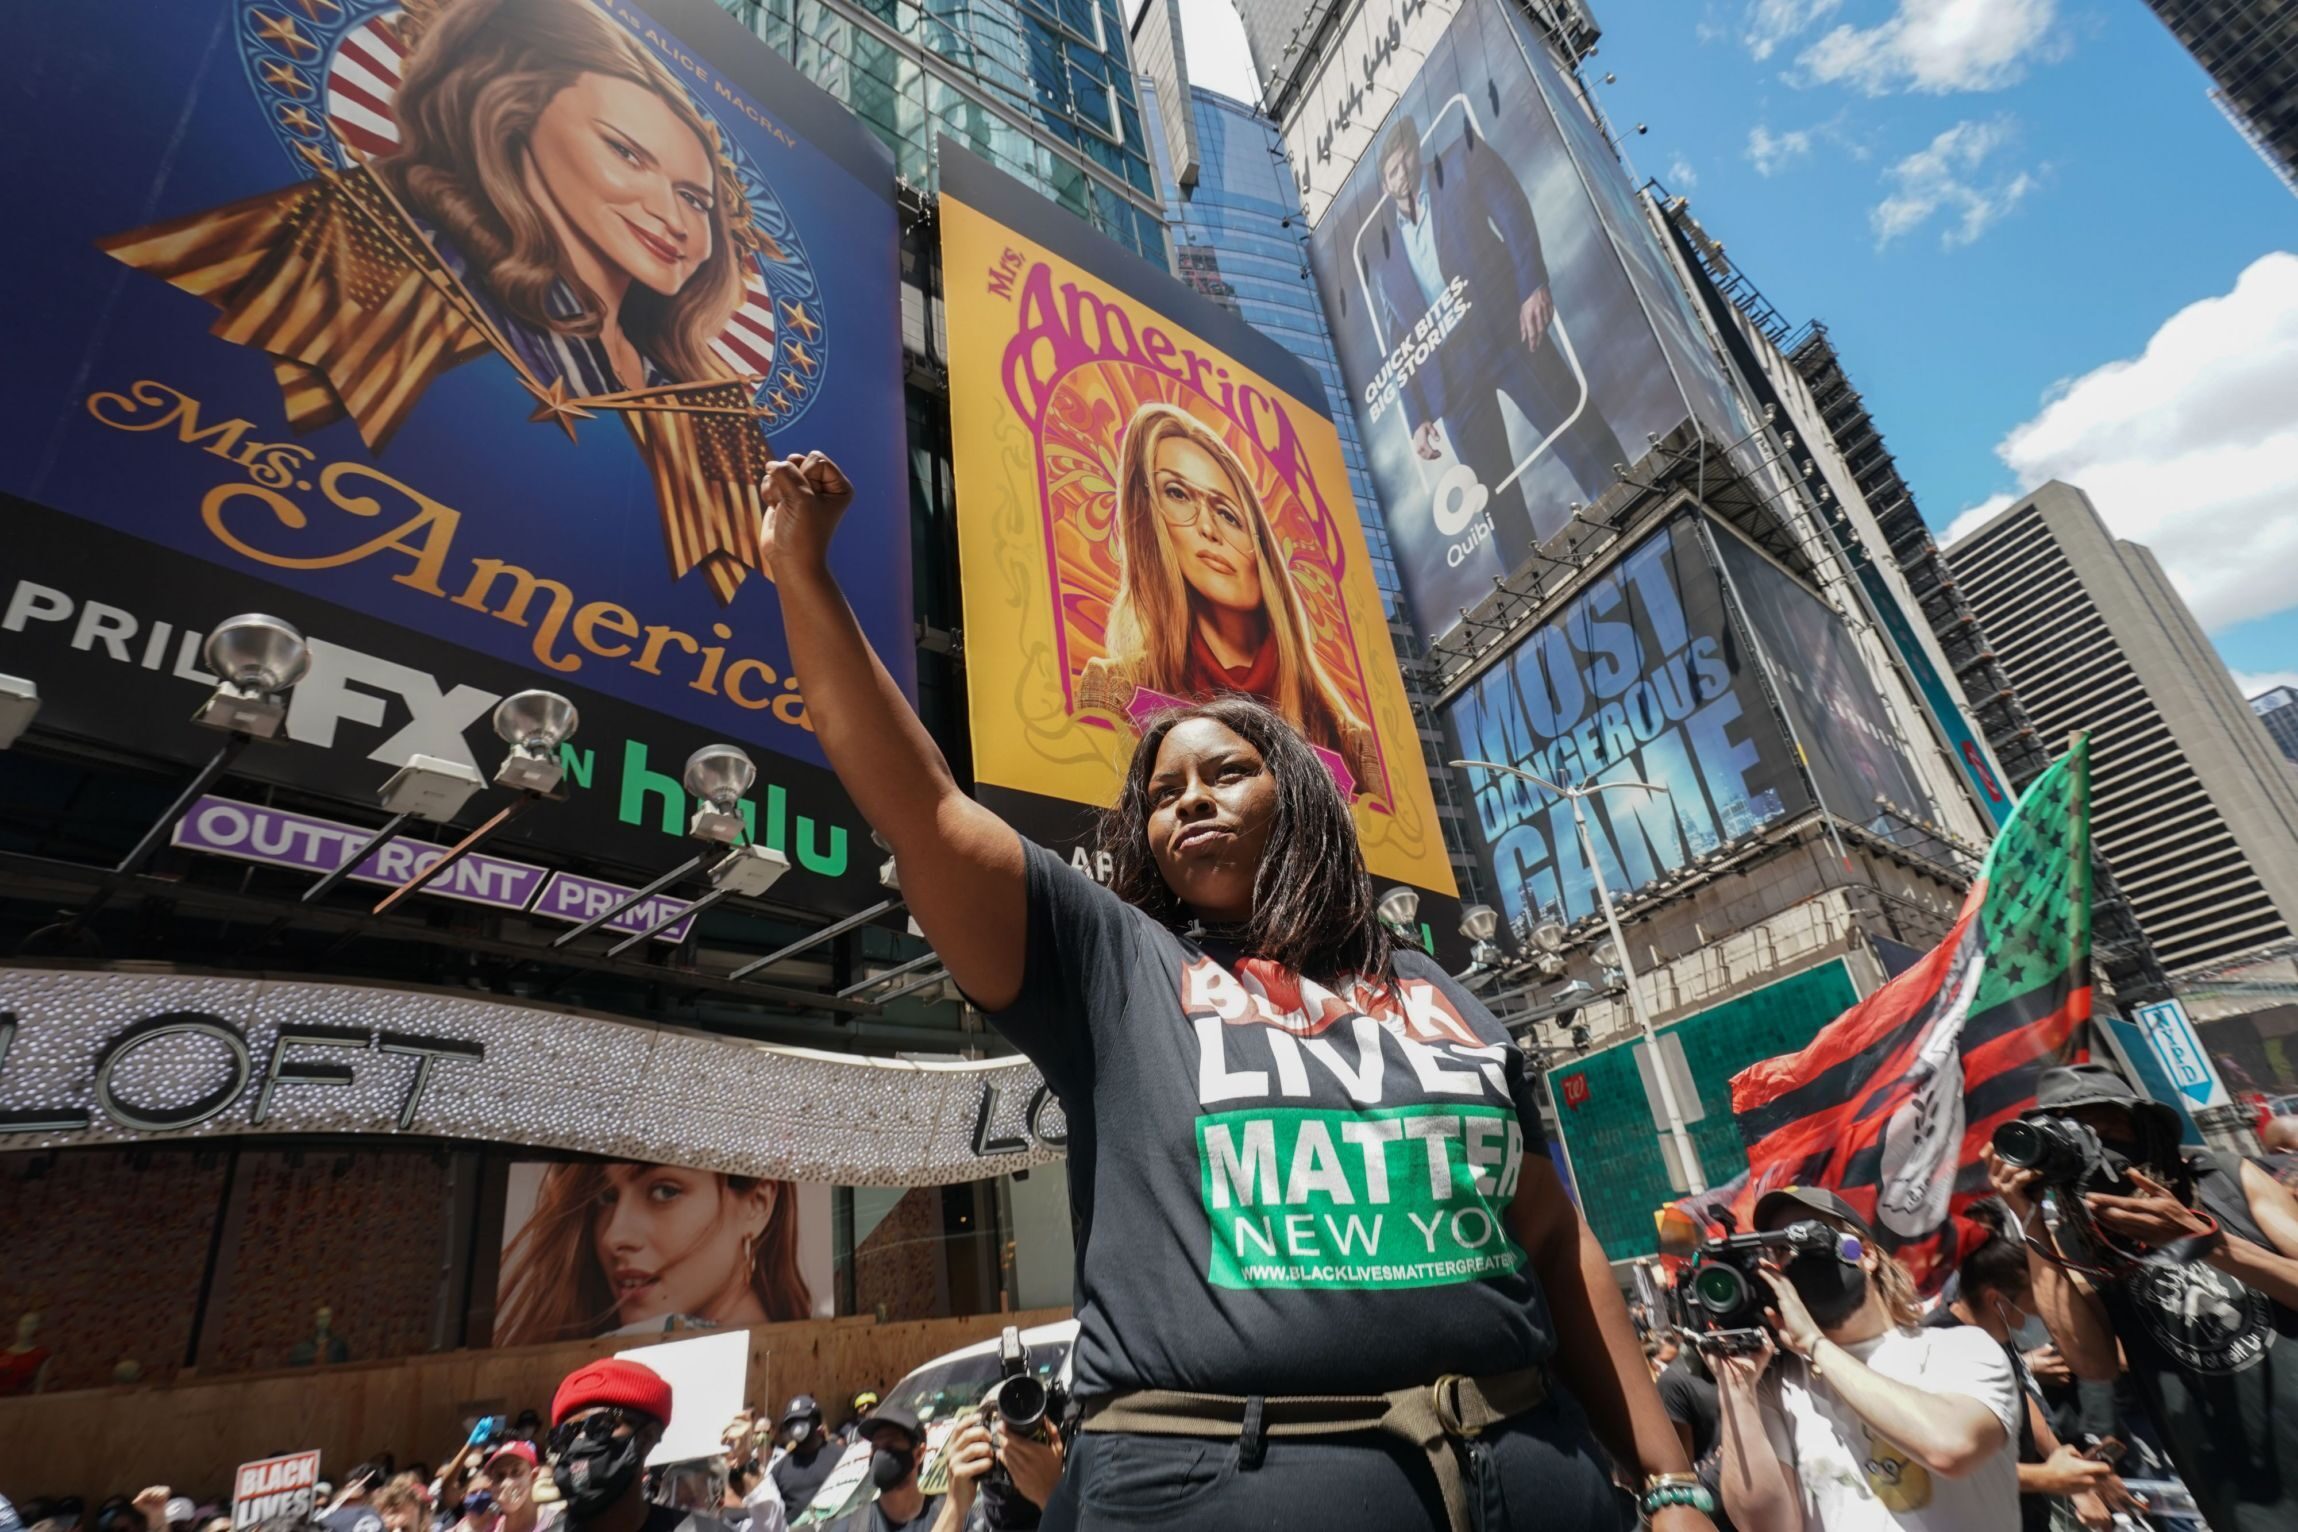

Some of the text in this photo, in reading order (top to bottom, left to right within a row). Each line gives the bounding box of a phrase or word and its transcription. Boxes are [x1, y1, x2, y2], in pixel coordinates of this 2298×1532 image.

[644, 29, 709, 83] ALICE
[714, 81, 796, 149] MACRAY
[1365, 275, 1469, 404] QUICK BITES.
[1369, 297, 1472, 424] BIG STORIES.
[86, 380, 316, 491] Mrs.
[202, 462, 815, 732] America
[1447, 512, 1495, 568] Quibi
[286, 637, 502, 789] FX
[1450, 527, 1692, 785] MOST
[1474, 635, 1732, 844] DANGEROUS
[197, 805, 685, 936] OUTFRONT PRIME
[1493, 690, 1786, 943] GAME
[0, 1011, 484, 1132] LOFT
[1235, 1207, 1500, 1257] NEW YO
[236, 1487, 311, 1530] LIVES
[239, 1457, 315, 1497] BLACK
